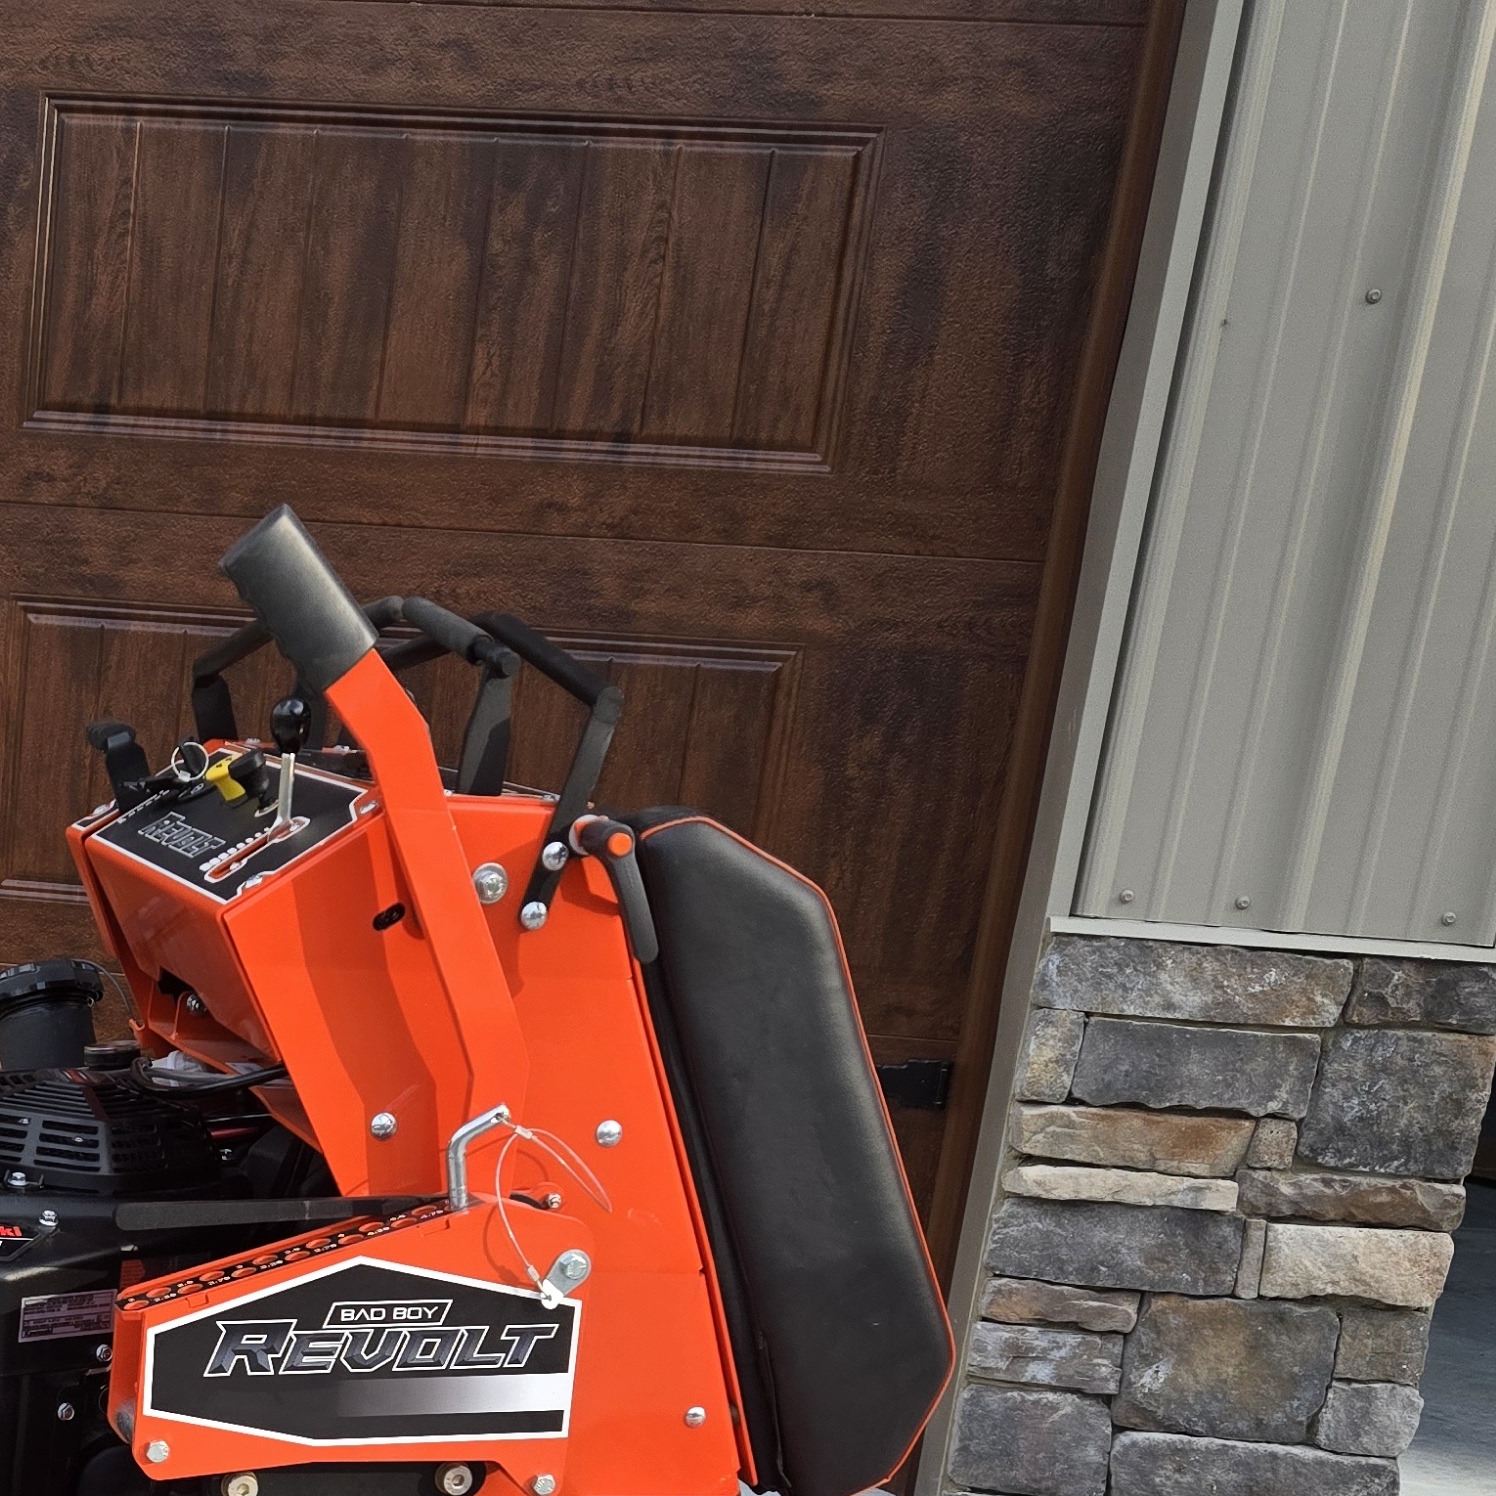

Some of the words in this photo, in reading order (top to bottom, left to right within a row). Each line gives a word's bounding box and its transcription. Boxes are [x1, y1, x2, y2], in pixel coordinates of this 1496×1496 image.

[340, 1306, 389, 1322] BAD
[393, 1306, 438, 1321] BOY
[203, 1319, 560, 1377] REVOLT
